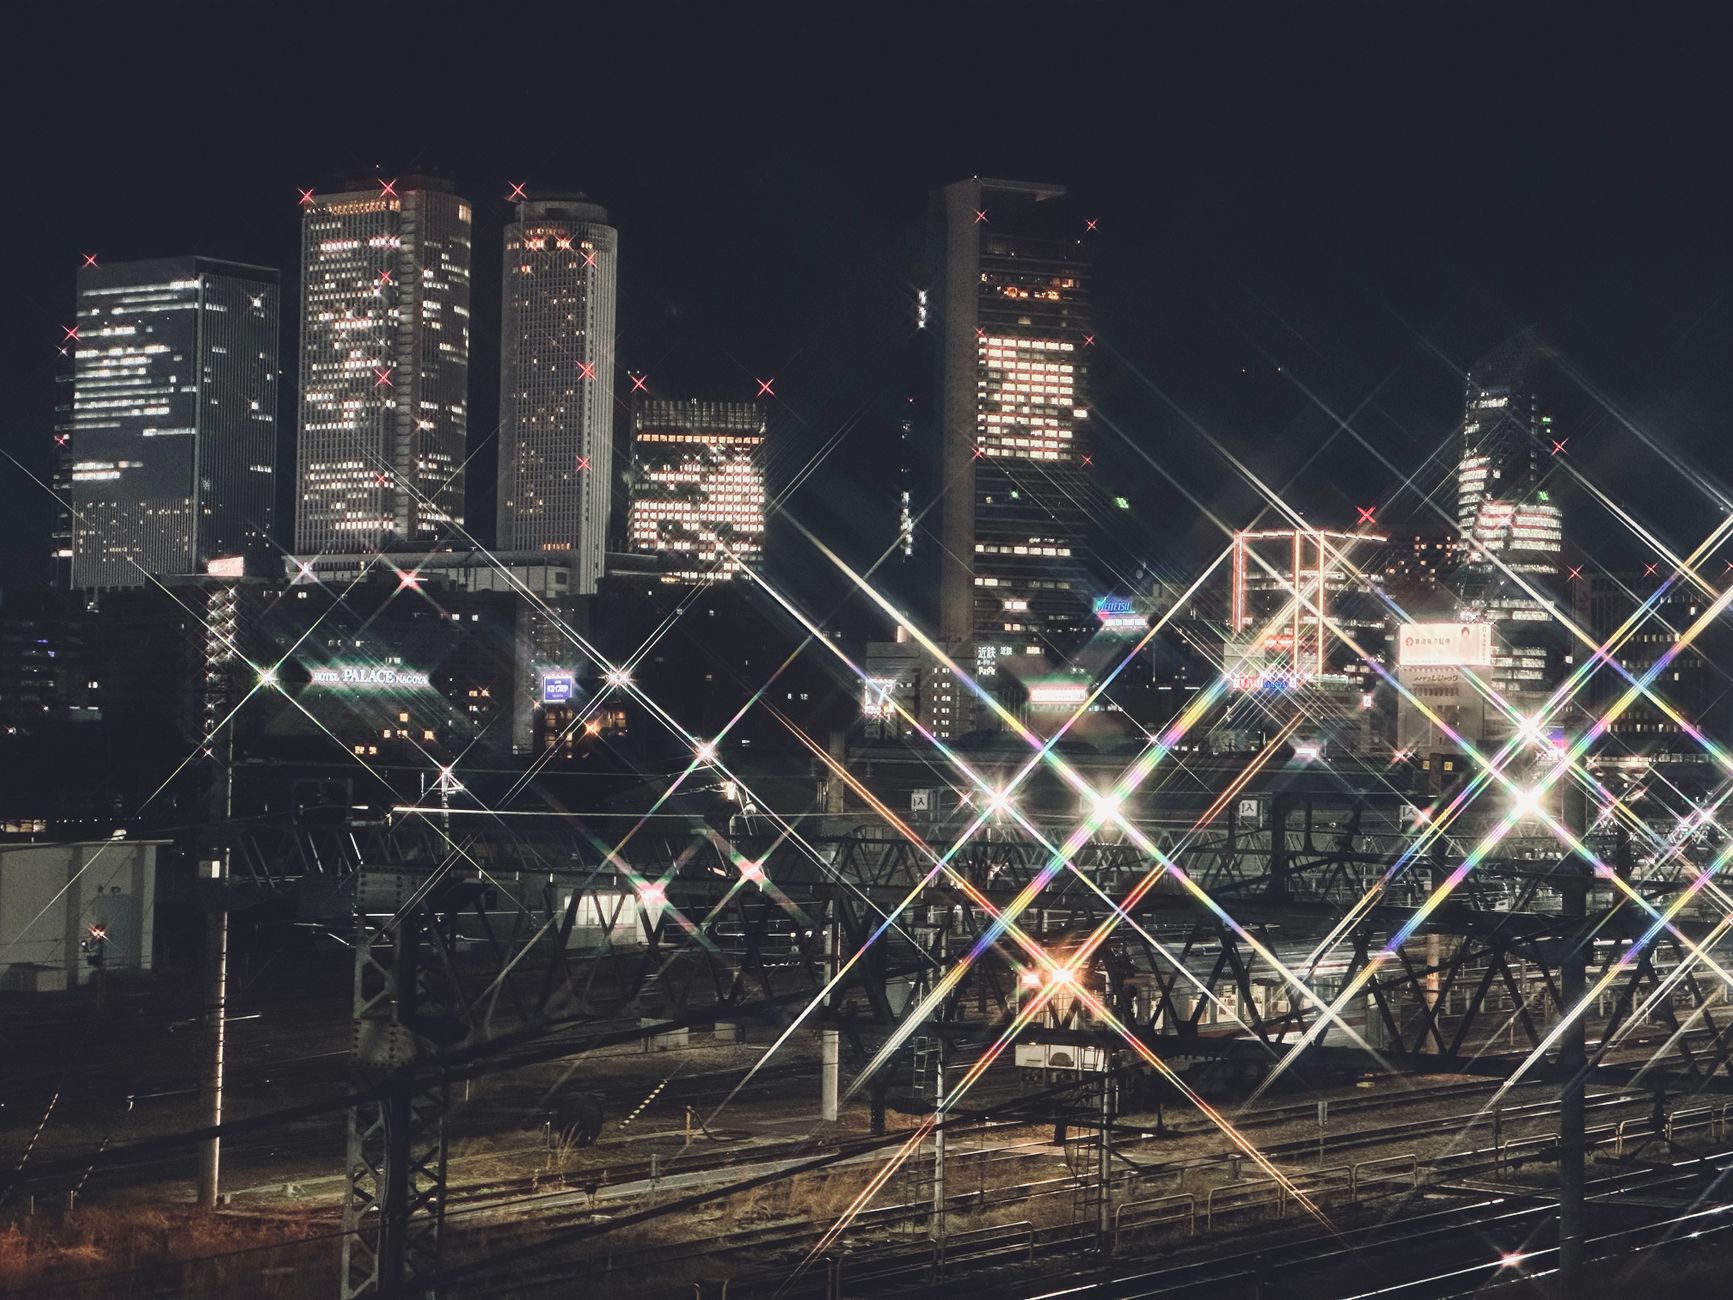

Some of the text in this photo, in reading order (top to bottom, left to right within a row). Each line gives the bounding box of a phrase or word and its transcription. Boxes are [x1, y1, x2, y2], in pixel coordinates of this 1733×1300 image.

[978, 646, 996, 659] 近鉄
[314, 669, 428, 684] HOTEL PALACE NAGOYA
